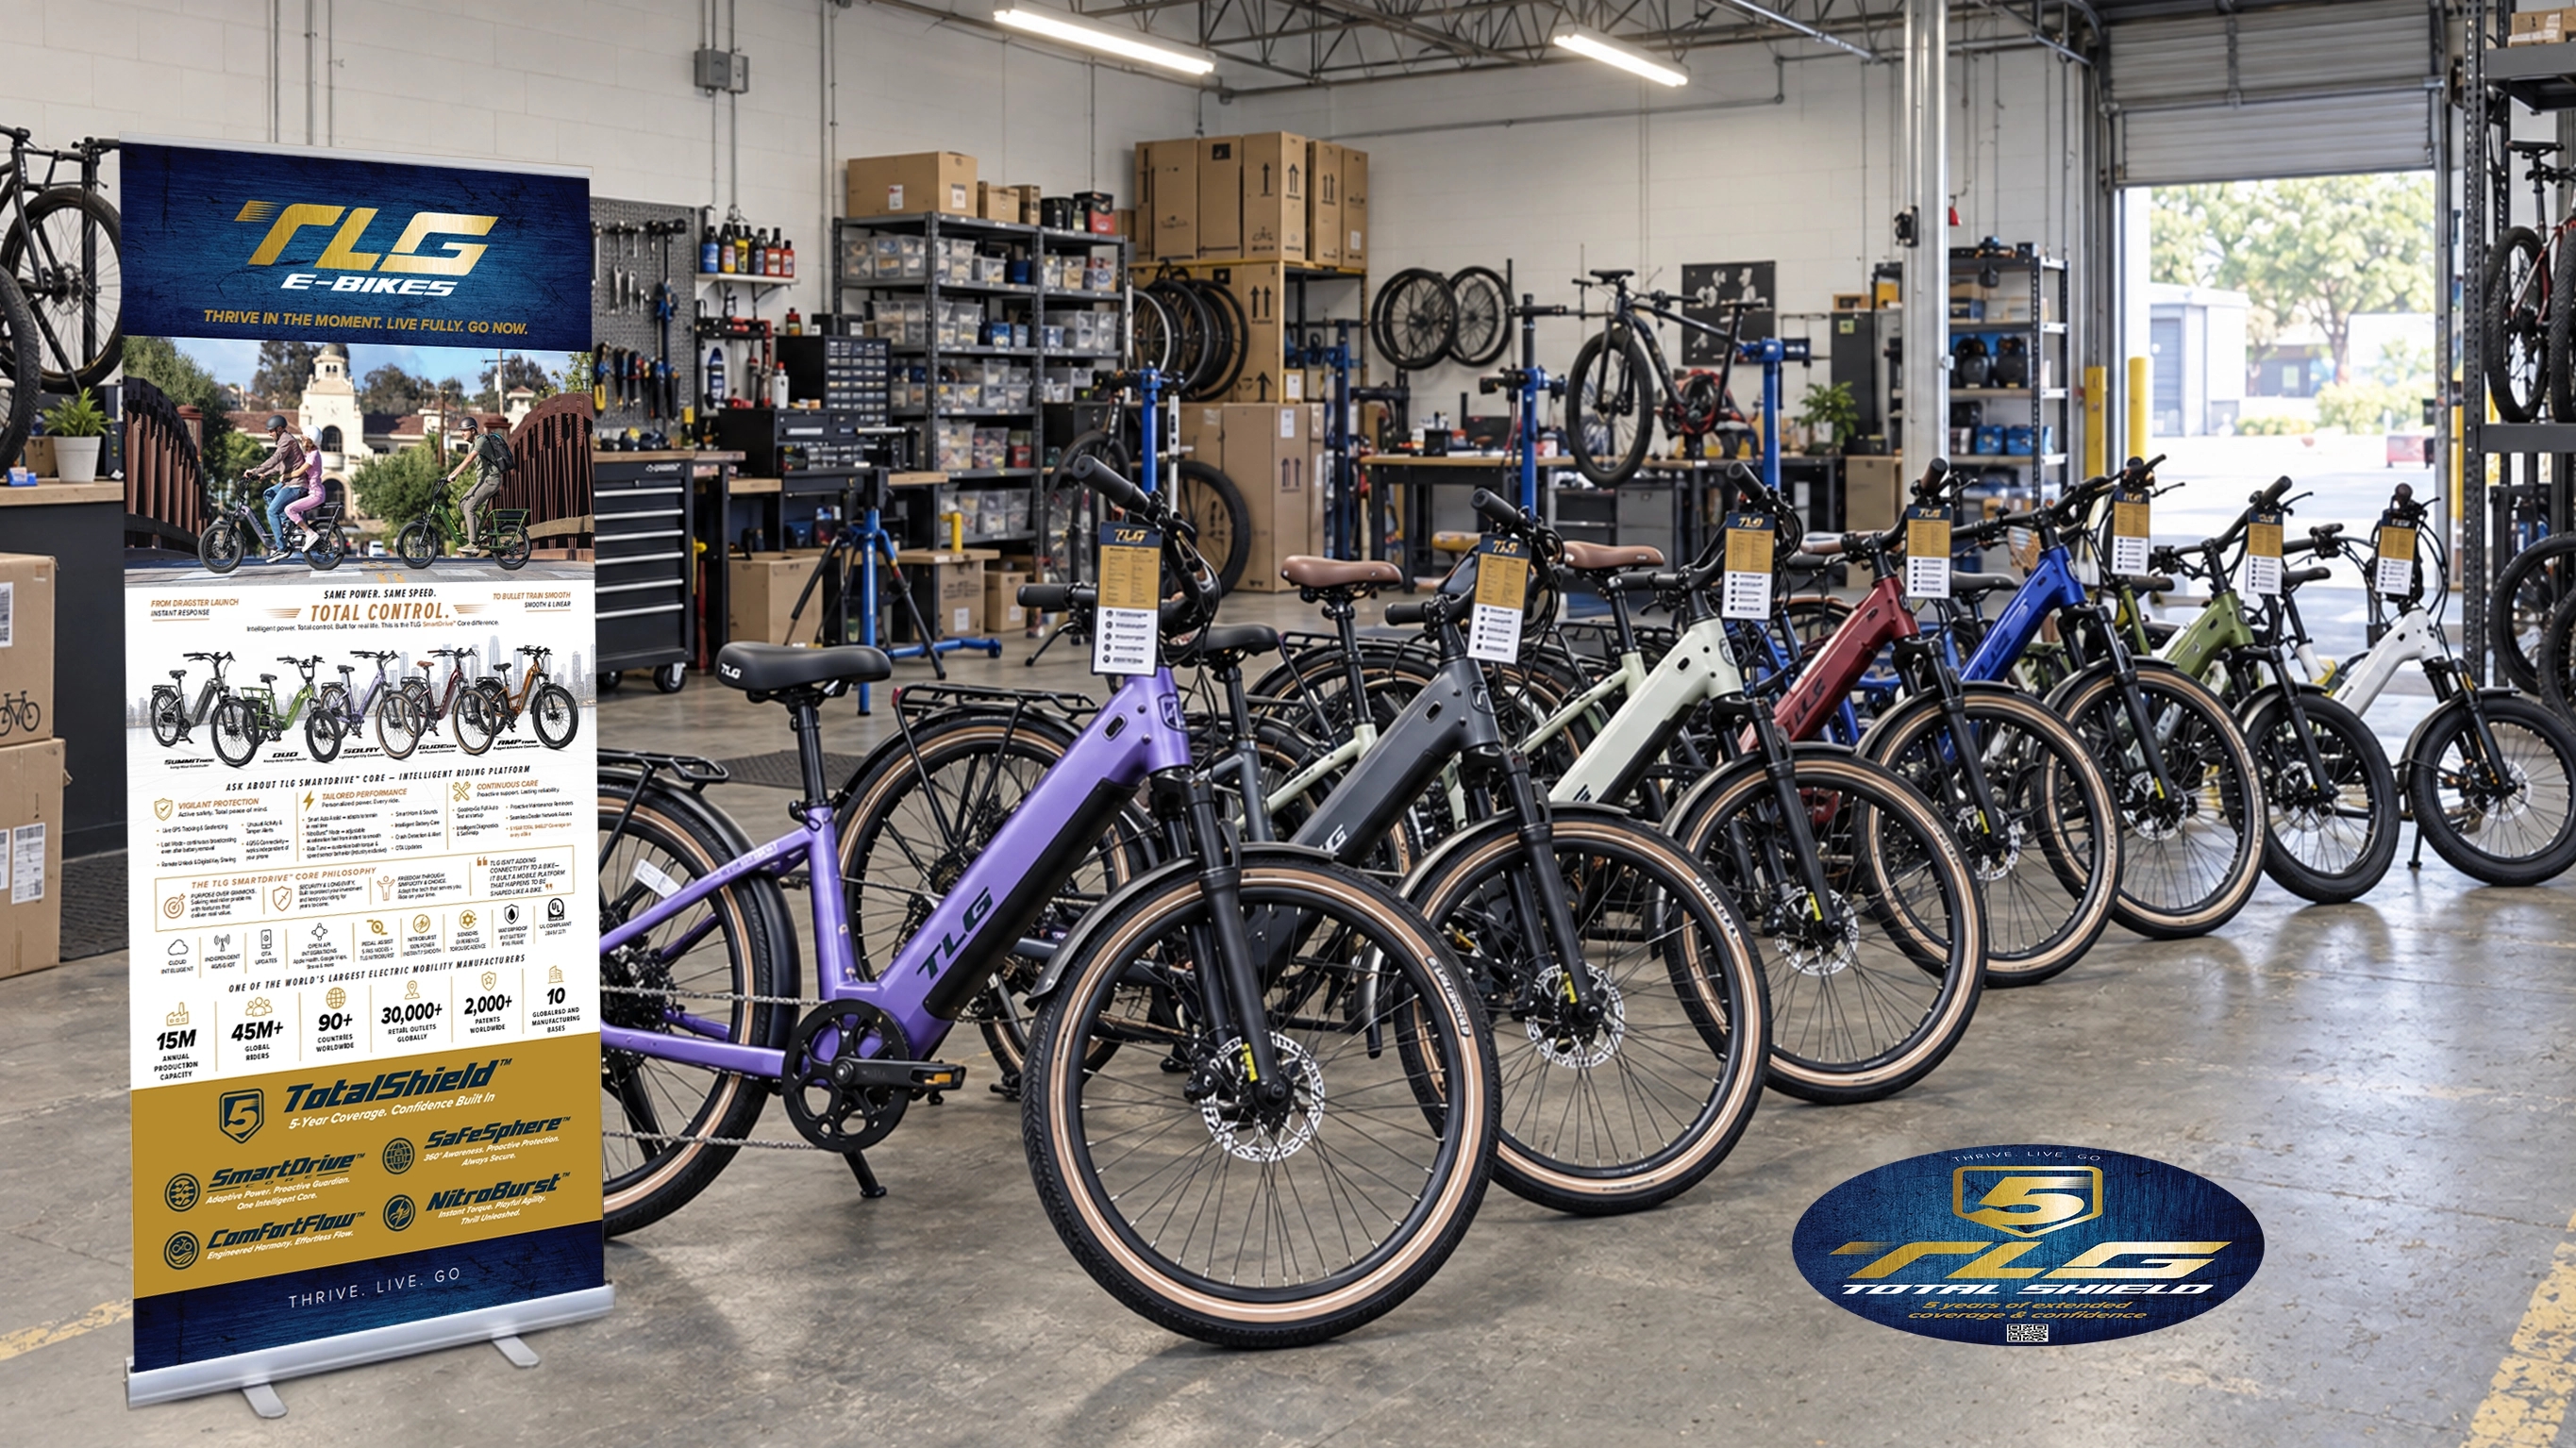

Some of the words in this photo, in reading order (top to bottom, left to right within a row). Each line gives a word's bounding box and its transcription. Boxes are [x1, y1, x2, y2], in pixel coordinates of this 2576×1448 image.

[235, 200, 497, 275] TLG
[280, 273, 458, 296] E-BIKES
[204, 309, 259, 324] THRIVE
[262, 312, 278, 324] IN
[283, 312, 312, 325] THE
[314, 314, 381, 328] MOMENT.
[387, 317, 417, 330] LIVE
[420, 319, 463, 331] FULLY.
[468, 321, 489, 332] GO
[492, 322, 527, 334] NOW.
[1114, 528, 1148, 542] TLG
[324, 590, 346, 599] SAME
[349, 589, 380, 598] POWER.
[383, 589, 406, 597] SAME
[409, 588, 436, 597] SPEED.
[310, 604, 359, 622] TOTAL
[367, 602, 448, 620] CONTROL.
[720, 662, 742, 679] TLG
[226, 782, 243, 791] ASK
[246, 780, 276, 790] ABOUT
[299, 775, 360, 787] SMARTDRIVE™
[362, 774, 385, 782] CORE
[398, 770, 452, 780] INTELLIGENT
[456, 768, 484, 776] RIDING
[488, 765, 529, 774] PLATFORM
[477, 780, 520, 790] CONTINUOUS
[322, 791, 355, 800] TAILORED
[356, 788, 407, 797] PERFORMANCE
[177, 800, 211, 809] VIGILANT
[212, 797, 259, 807] PROTECTION
[192, 880, 209, 889] THE
[212, 878, 228, 887] TLG
[231, 874, 293, 885] SMARTDRIVE™
[294, 872, 318, 880] CORE
[322, 867, 376, 877] PHILOSOPHY
[916, 886, 994, 980] TLG
[228, 983, 245, 992] ONE
[249, 981, 260, 990] OF
[265, 979, 280, 989] THE
[285, 974, 324, 986] WORLD'S
[328, 971, 364, 982] LARGEST
[368, 966, 409, 977] ELECTRIC
[412, 961, 453, 973] MOBILITY
[456, 954, 525, 968] MANUFACTURERS
[546, 987, 565, 1005] 10
[464, 993, 511, 1016] 2,000+
[380, 1002, 442, 1024] 30,000+
[531, 1015, 579, 1025] MANUFACTURING
[318, 1012, 352, 1031] 90+
[410, 1024, 436, 1032] OUTLETS
[469, 1024, 505, 1033] WORLDWIDE
[547, 1024, 564, 1033] BASES
[230, 1020, 283, 1040] 45M+
[317, 1033, 352, 1043] COUNTRIES
[396, 1033, 427, 1042] GLOBALLY
[157, 1028, 196, 1050] 15M
[316, 1041, 354, 1052] WORLDWIDE
[244, 1043, 270, 1052] GLOBAL
[162, 1053, 189, 1061] ANNUAL
[245, 1052, 269, 1060] RIDERS
[154, 1061, 197, 1072] PRODUCTION
[159, 1071, 192, 1080] CAPACITY
[289, 1116, 328, 1129] 5-Year
[330, 1108, 386, 1123] Coverage.
[391, 1099, 453, 1114] Confidence
[455, 1093, 482, 1106] Built
[483, 1091, 494, 1102] In
[423, 1152, 443, 1161] 360°
[442, 1147, 483, 1158] Awareness.
[485, 1140, 520, 1152] Proactive
[521, 1135, 559, 1146] Protection.
[460, 1157, 488, 1166] Always
[489, 1153, 515, 1161] Secure.
[1952, 1151, 2018, 1162] THRIVE.
[205, 1192, 242, 1204] Adaptive
[243, 1189, 271, 1198] Power.
[273, 1182, 310, 1193] Proactive
[312, 1176, 349, 1188] Guardian.
[255, 1194, 295, 1207] Intelligent
[438, 1207, 465, 1218] Instant
[466, 1204, 493, 1213] Torque.
[494, 1198, 521, 1208] Playful
[521, 1194, 545, 1205] Agility.
[1978, 1176, 2094, 1225] 5
[460, 1215, 480, 1224] Thrill
[480, 1208, 520, 1221] Unleashed.
[207, 1244, 254, 1259] Engineered
[254, 1240, 292, 1251] Harmony.
[294, 1234, 331, 1244] Effortless
[332, 1230, 353, 1239] Flow.
[1829, 1241, 2233, 1279] TLG
[288, 1284, 364, 1307] THRIVE.
[376, 1274, 423, 1292] LIVE.
[434, 1267, 459, 1282] GO
[1842, 1284, 1999, 1295] TOTAL
[2016, 1284, 2215, 1295] SHIELD
[1922, 1301, 1941, 1309] 5
[2004, 1301, 2031, 1309] of
[2032, 1301, 2133, 1309] extended
